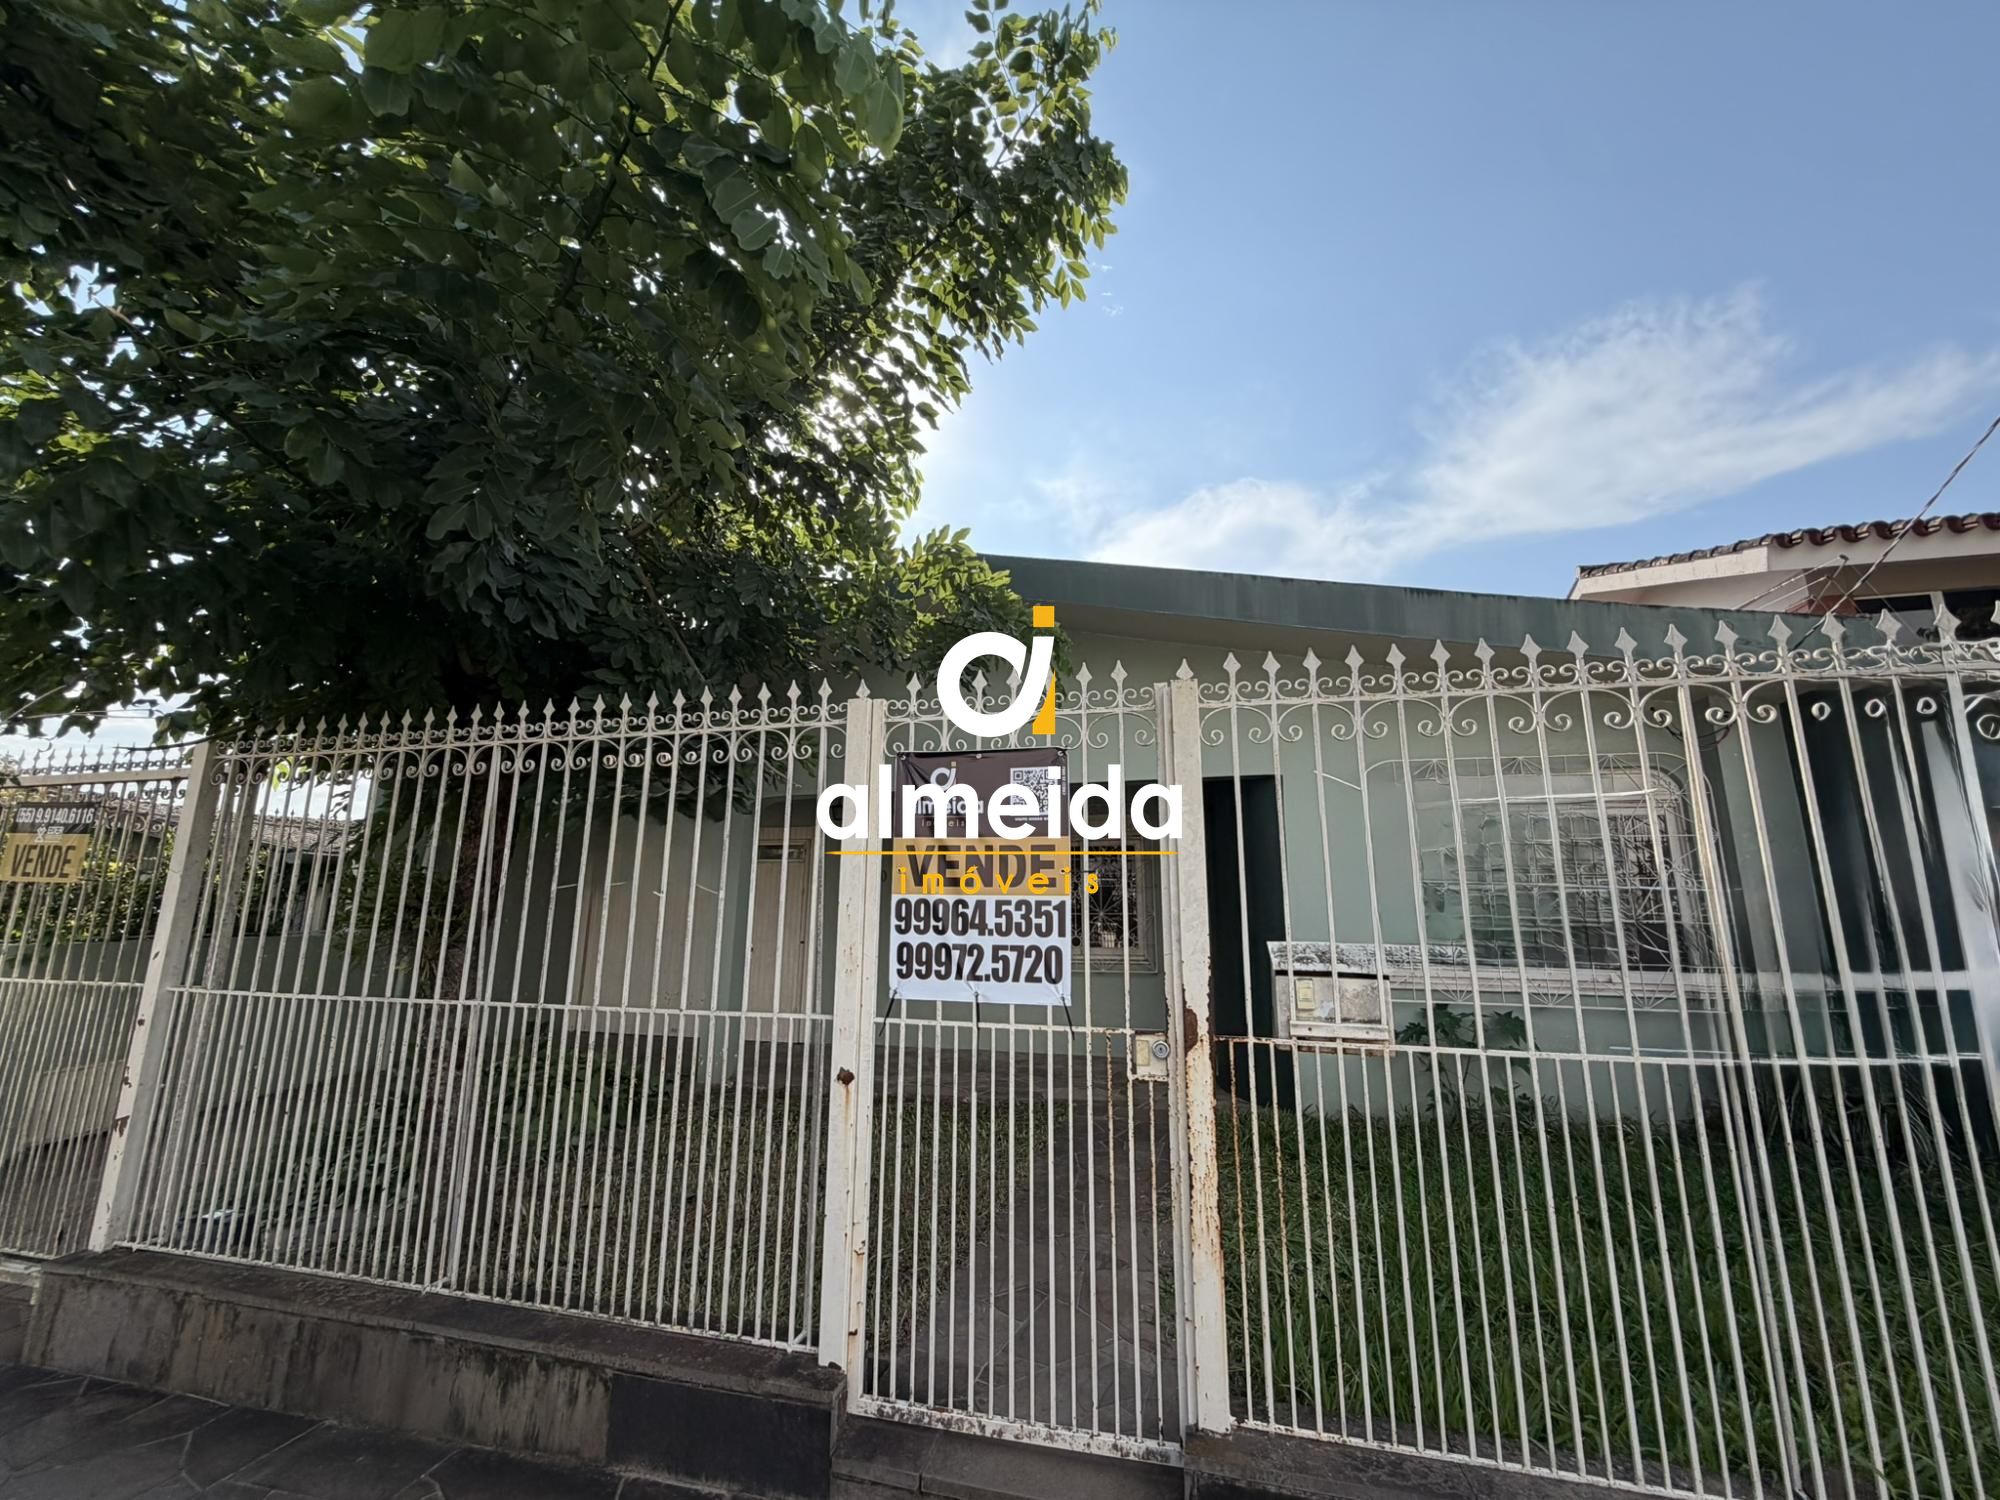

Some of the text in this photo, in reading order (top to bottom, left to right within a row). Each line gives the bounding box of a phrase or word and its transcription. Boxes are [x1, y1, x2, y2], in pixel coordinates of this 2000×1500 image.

[11, 844, 76, 878] VENDE
[905, 844, 1057, 889] VENDE
[894, 897, 1067, 938] 99964.5351
[896, 941, 1064, 985] 99972.5720
